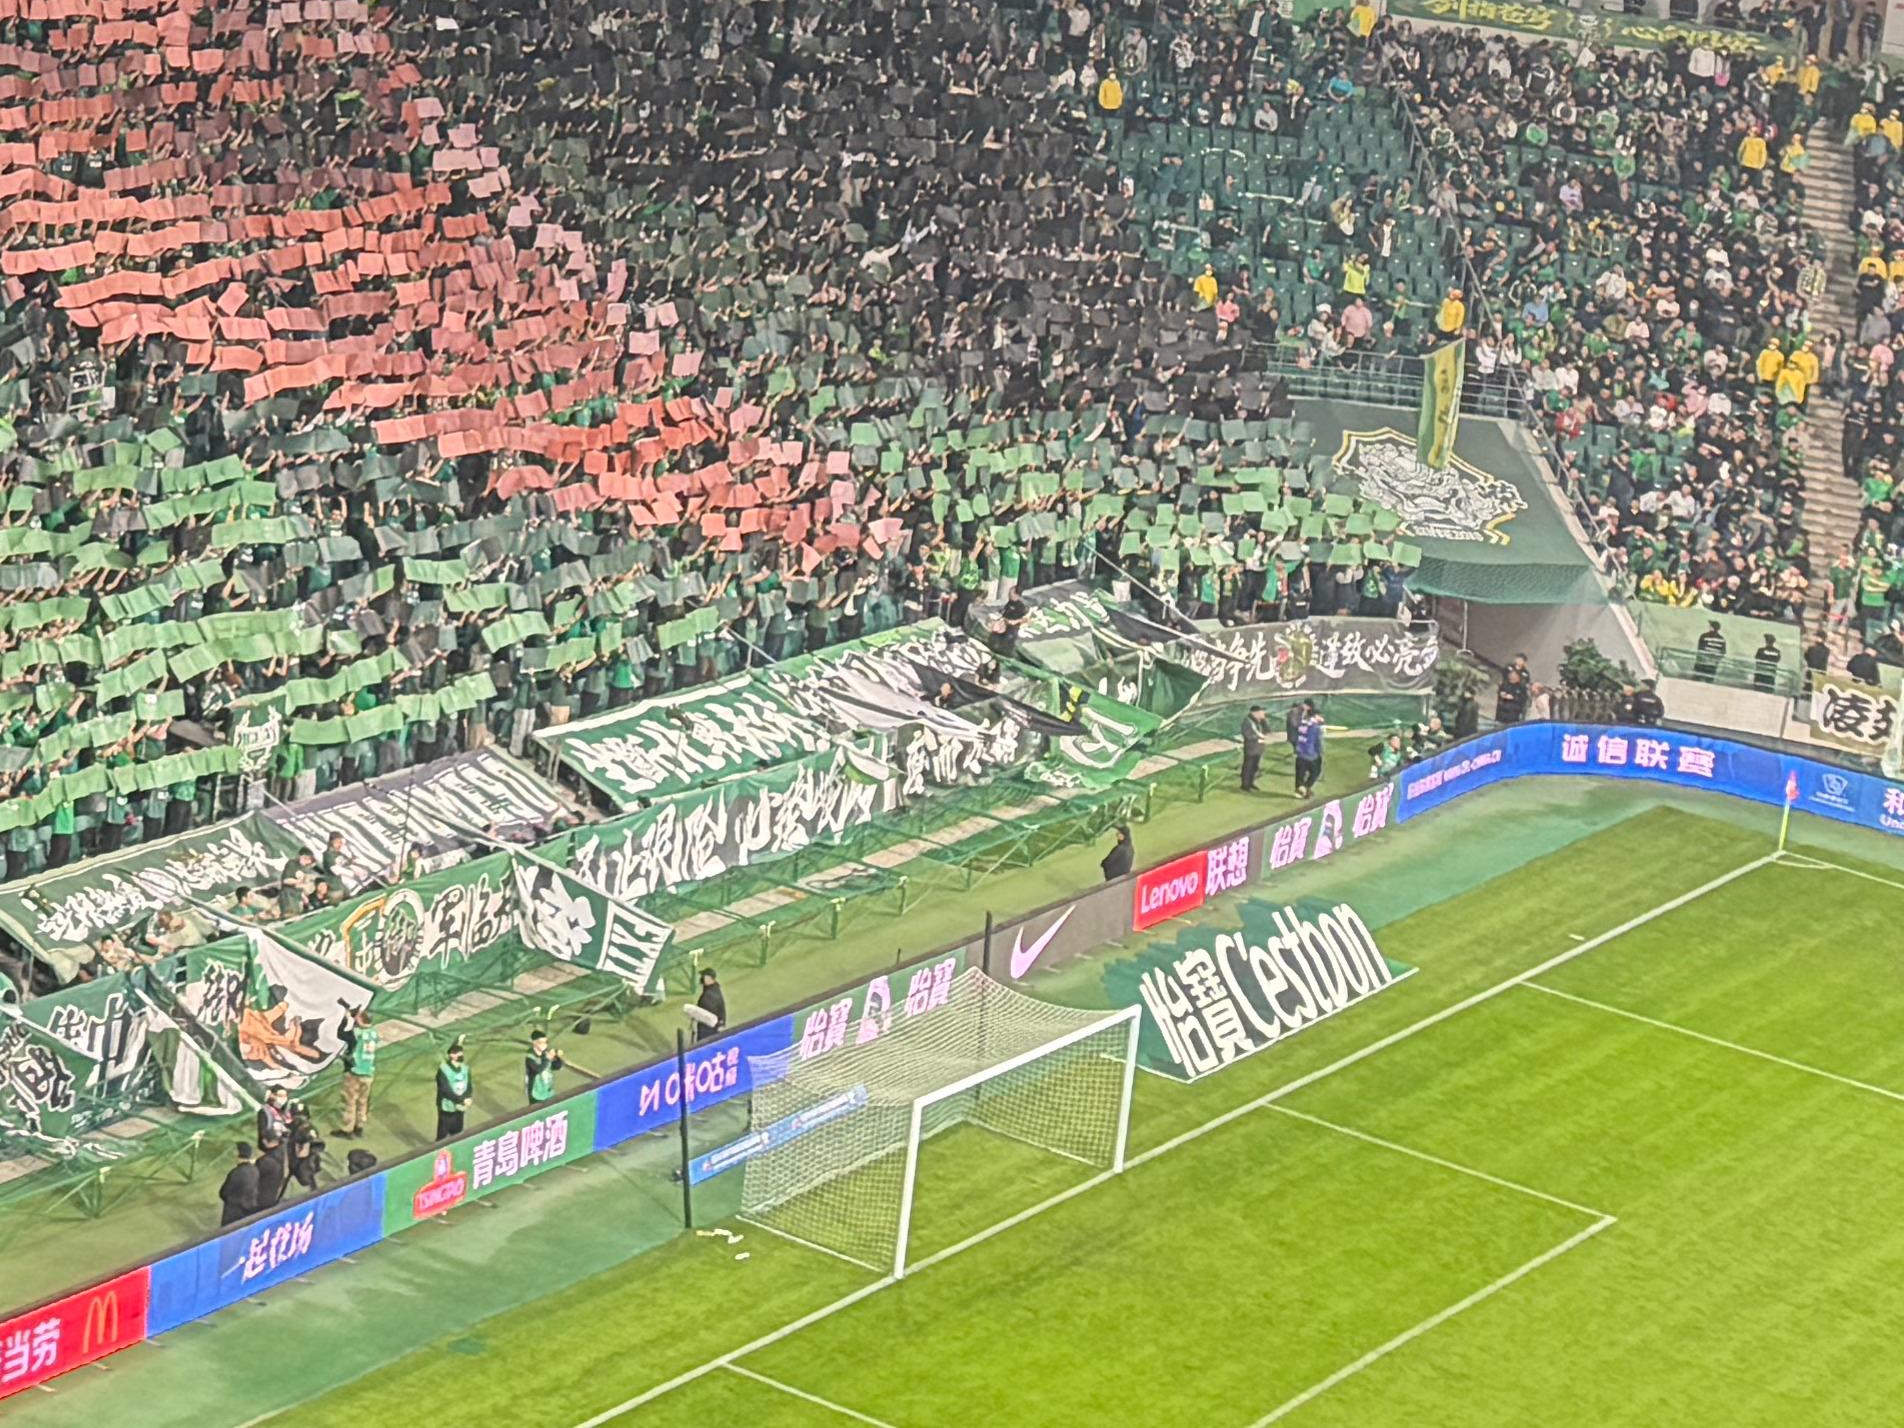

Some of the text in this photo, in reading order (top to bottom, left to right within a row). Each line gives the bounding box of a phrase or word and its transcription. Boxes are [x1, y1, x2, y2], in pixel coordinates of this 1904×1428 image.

[1561, 733, 1717, 779] 诚信联赛
[1140, 835, 1250, 915] Lenovo 联想
[472, 1110, 569, 1190] 青岛啤酒
